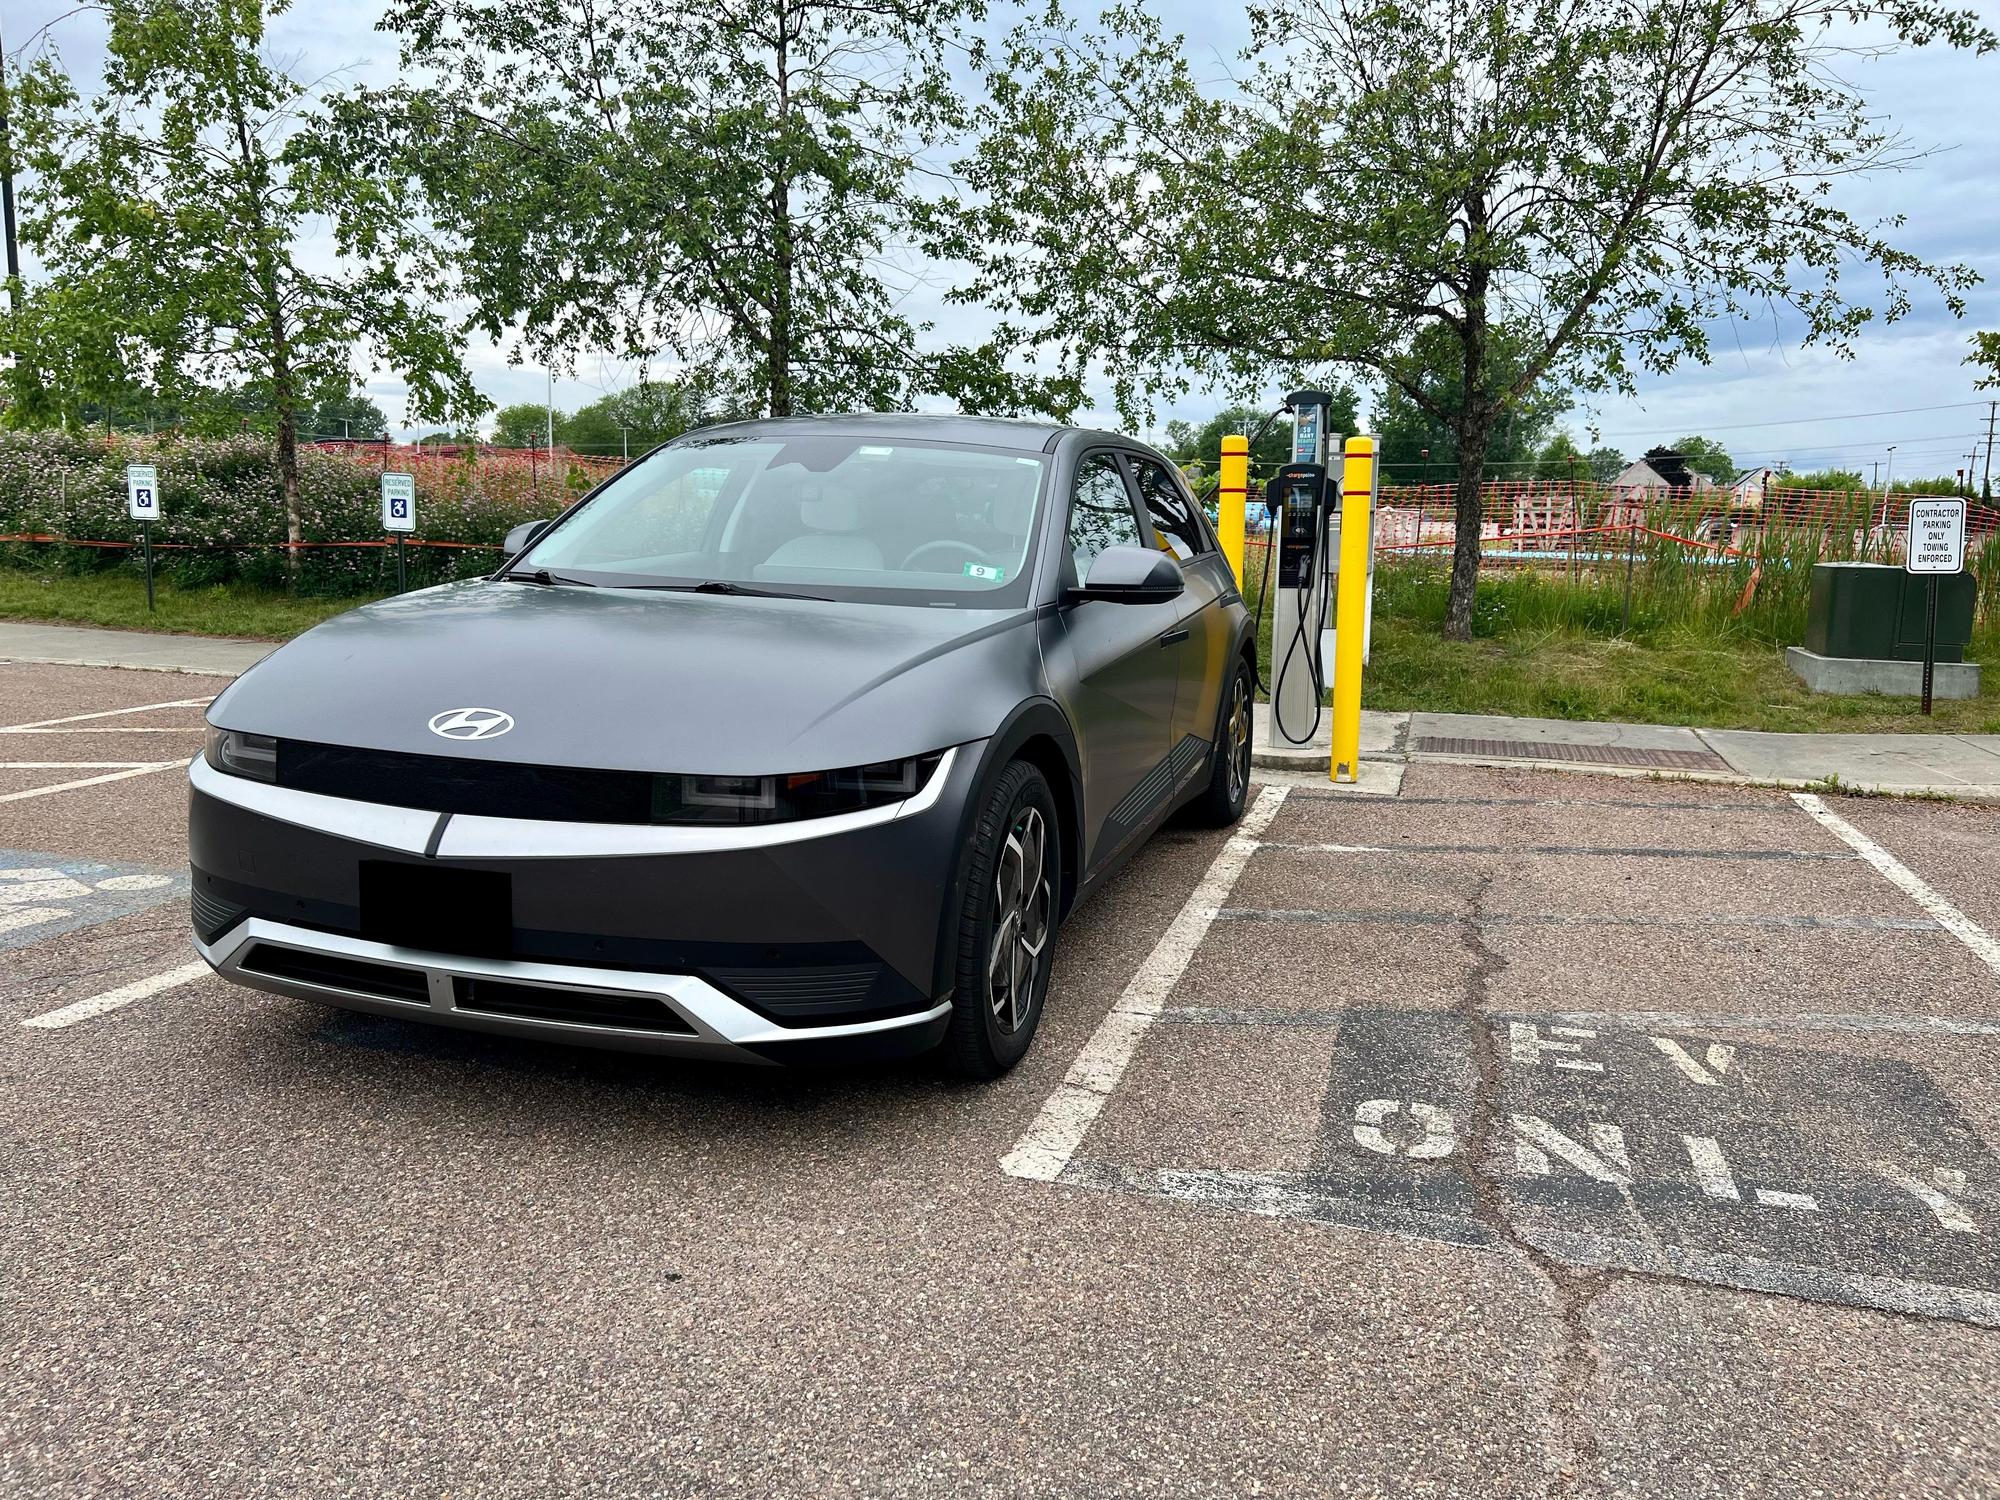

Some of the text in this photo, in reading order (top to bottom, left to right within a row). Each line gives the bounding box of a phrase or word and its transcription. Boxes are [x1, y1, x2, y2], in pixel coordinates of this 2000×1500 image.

[130, 470, 154, 478] RESERVED
[132, 479, 153, 487] PARKING
[384, 478, 411, 488] RESERVED
[387, 488, 410, 497] PARKING
[1916, 509, 1960, 518] CONTRACTOR
[1922, 520, 1951, 529] PARKING
[1928, 531, 1945, 540] ONLY
[1923, 543, 1949, 552] TOWING
[1918, 554, 1953, 563] ENFORCED
[976, 567, 985, 576] 9
[1509, 1021, 1736, 1086] EV
[1352, 1098, 1981, 1234] ONLY
